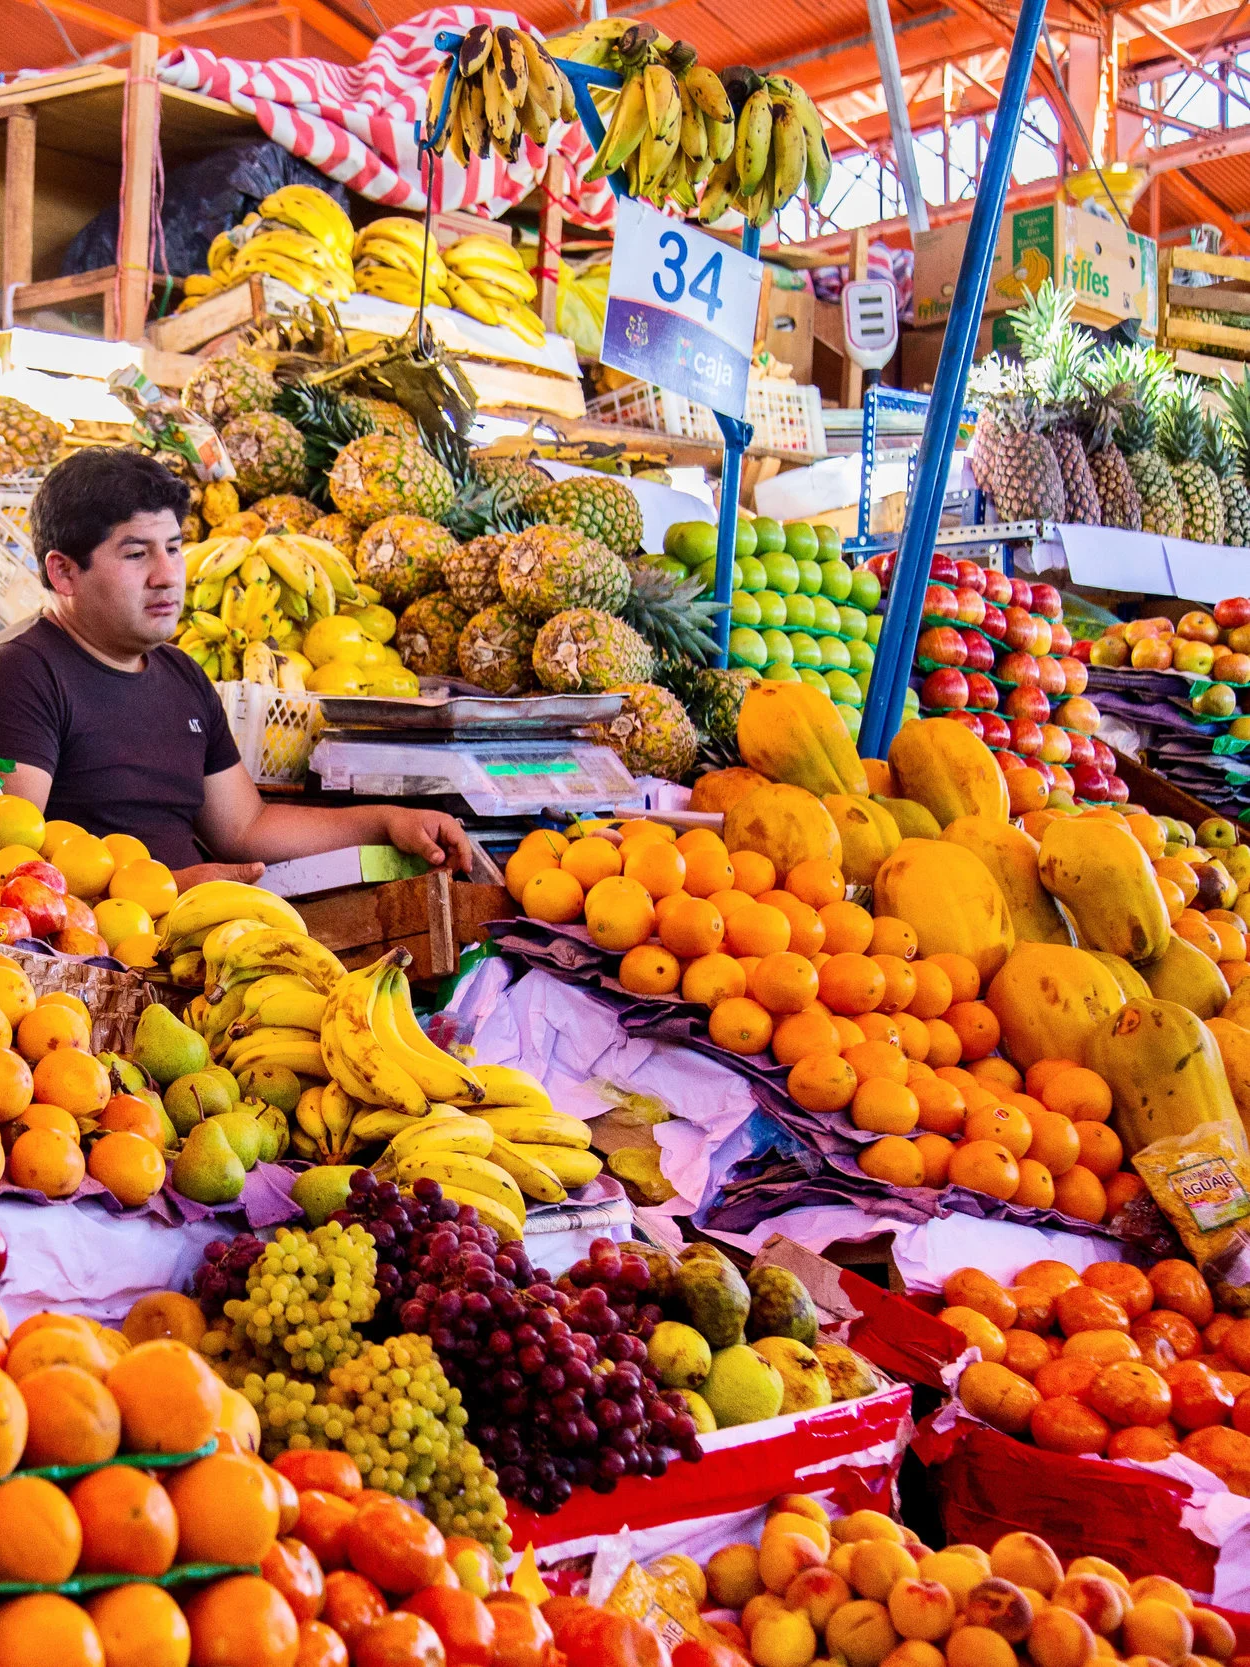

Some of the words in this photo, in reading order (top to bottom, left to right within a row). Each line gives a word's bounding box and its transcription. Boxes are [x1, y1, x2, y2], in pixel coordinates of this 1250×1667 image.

[652, 231, 723, 322] 34
[693, 352, 733, 387] caja
[1182, 1171, 1234, 1198] AGUAJE
